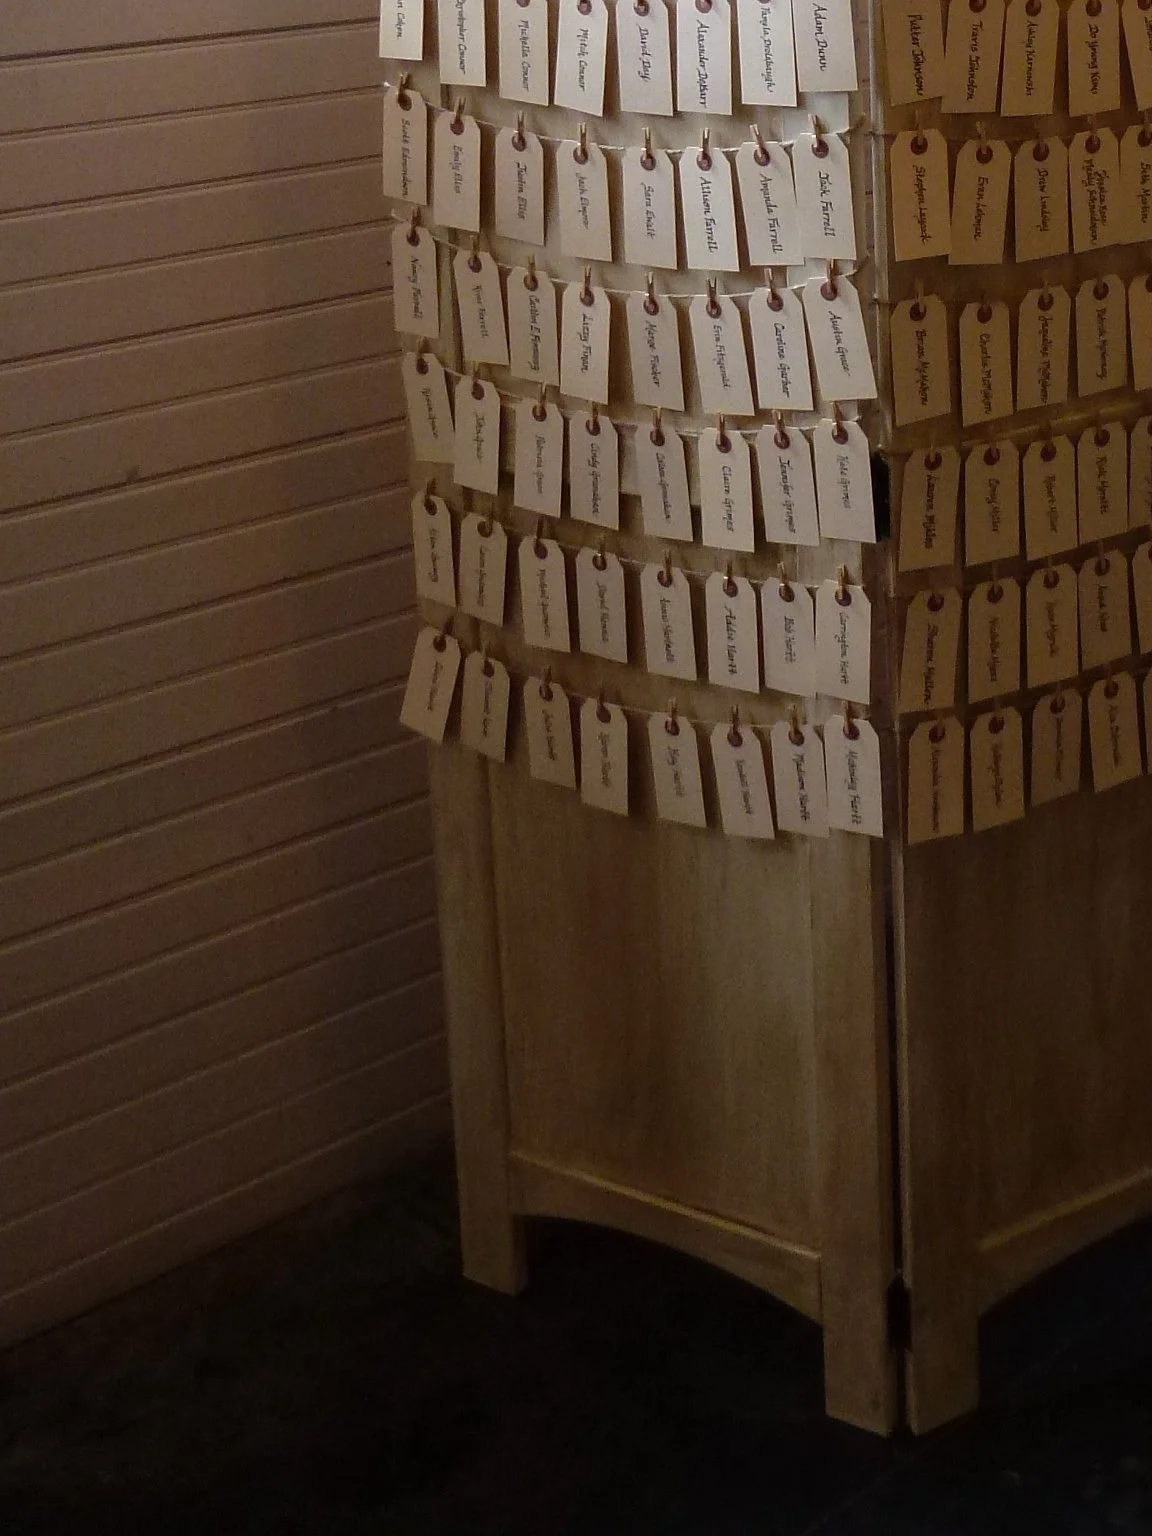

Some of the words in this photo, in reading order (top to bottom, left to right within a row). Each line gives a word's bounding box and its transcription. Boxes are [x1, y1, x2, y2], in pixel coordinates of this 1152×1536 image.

[812, 2, 828, 38] Adam
[969, 19, 984, 53] Travis
[517, 19, 531, 59] Michelle
[576, 28, 589, 57] Mitch
[638, 25, 652, 58] David
[696, 19, 710, 70] Alexander
[814, 37, 829, 72] Dunn
[457, 43, 468, 75] Connor
[521, 60, 531, 92] Connor
[578, 59, 588, 92] Connor
[637, 57, 652, 83] Day
[911, 48, 927, 97] Johnson
[451, 144, 463, 172] Emily
[640, 182, 655, 208] Sara
[700, 176, 712, 216] Allison
[759, 172, 778, 215] Amanda
[818, 170, 833, 198] Jack
[704, 217, 719, 254] Farrell
[768, 217, 784, 255] Farrell
[820, 200, 836, 237] Farrell
[713, 324, 723, 346] Erin
[773, 322, 787, 361] Caroline
[828, 310, 844, 349] Austin
[778, 455, 794, 498] Jennifer
